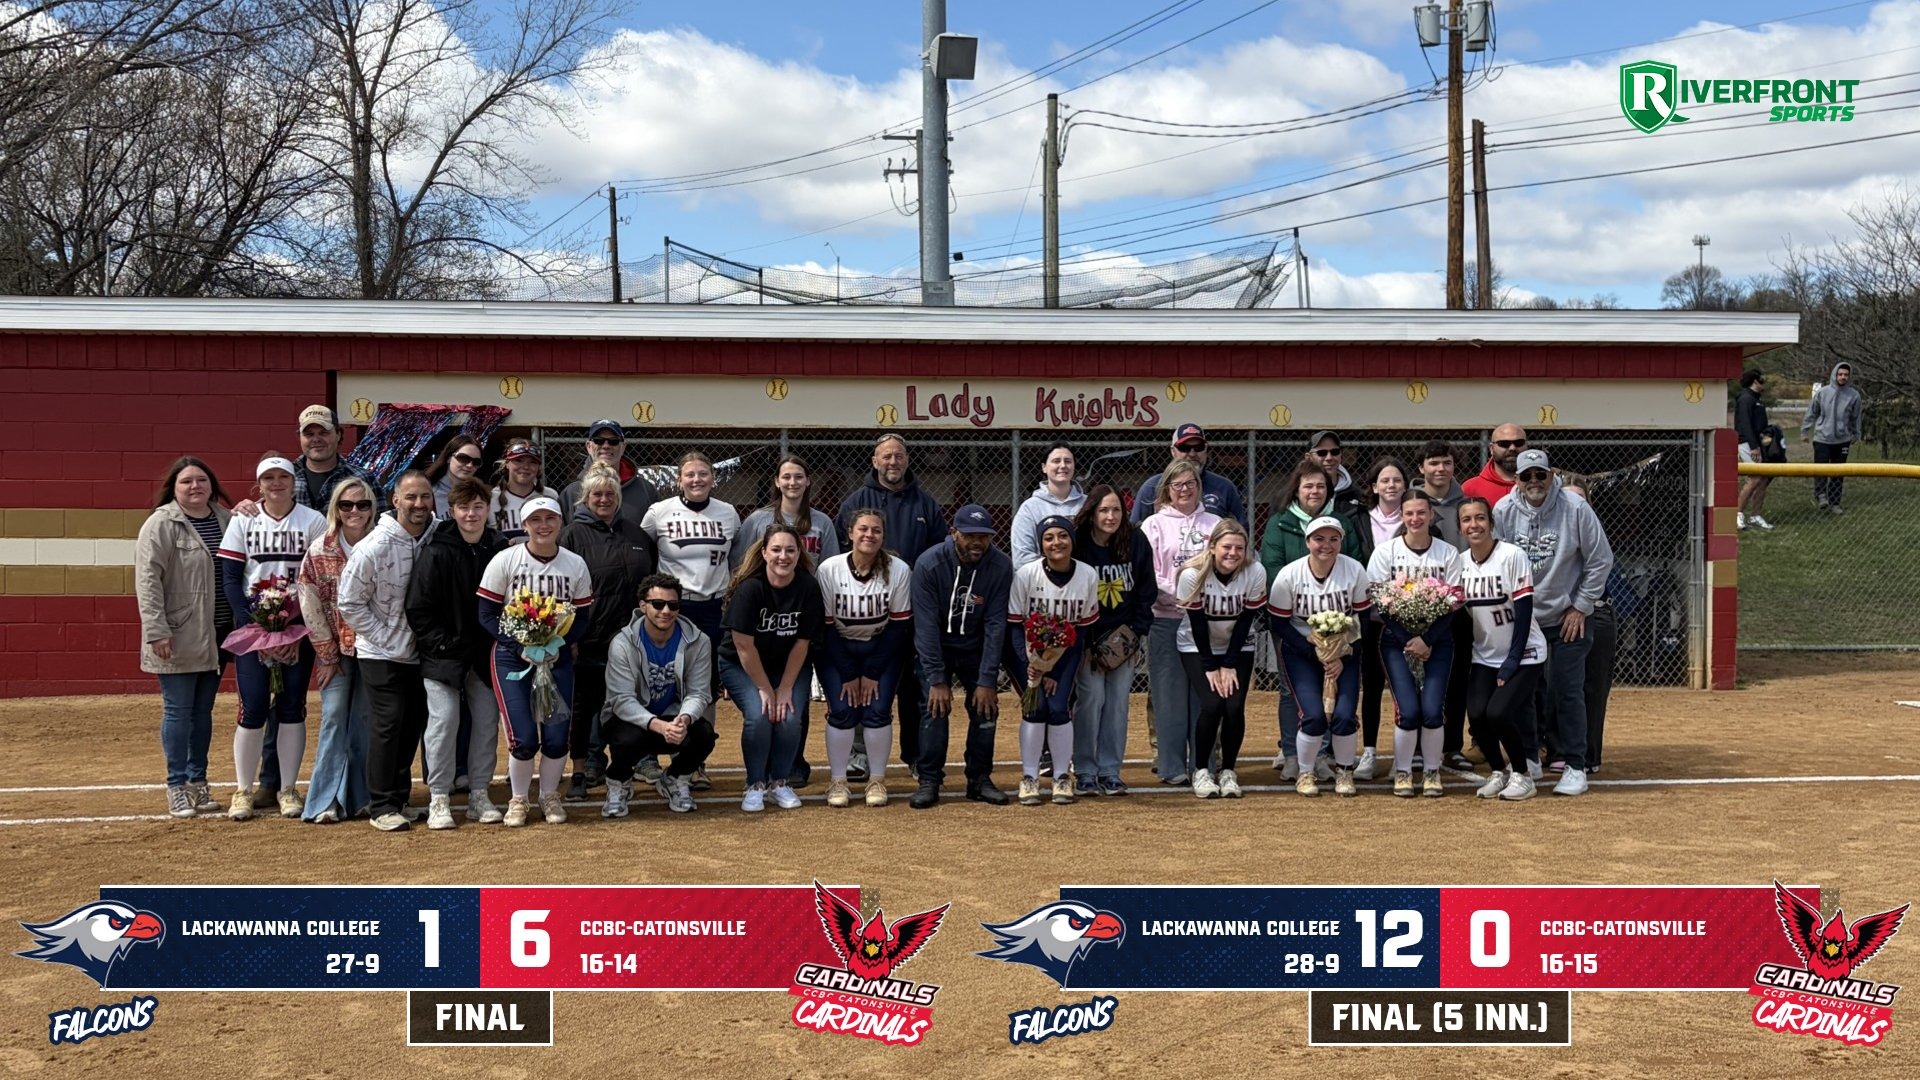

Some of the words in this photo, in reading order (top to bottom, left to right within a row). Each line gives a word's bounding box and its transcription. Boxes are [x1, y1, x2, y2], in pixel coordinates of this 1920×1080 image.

[906, 383, 995, 427] Lady
[1035, 386, 1160, 427] Knights
[667, 521, 724, 538] FALCONS
[247, 531, 304, 554] FALCONS
[512, 575, 571, 599] FALCONS
[836, 593, 890, 617] FALCONS
[1296, 591, 1351, 615] FALCONS
